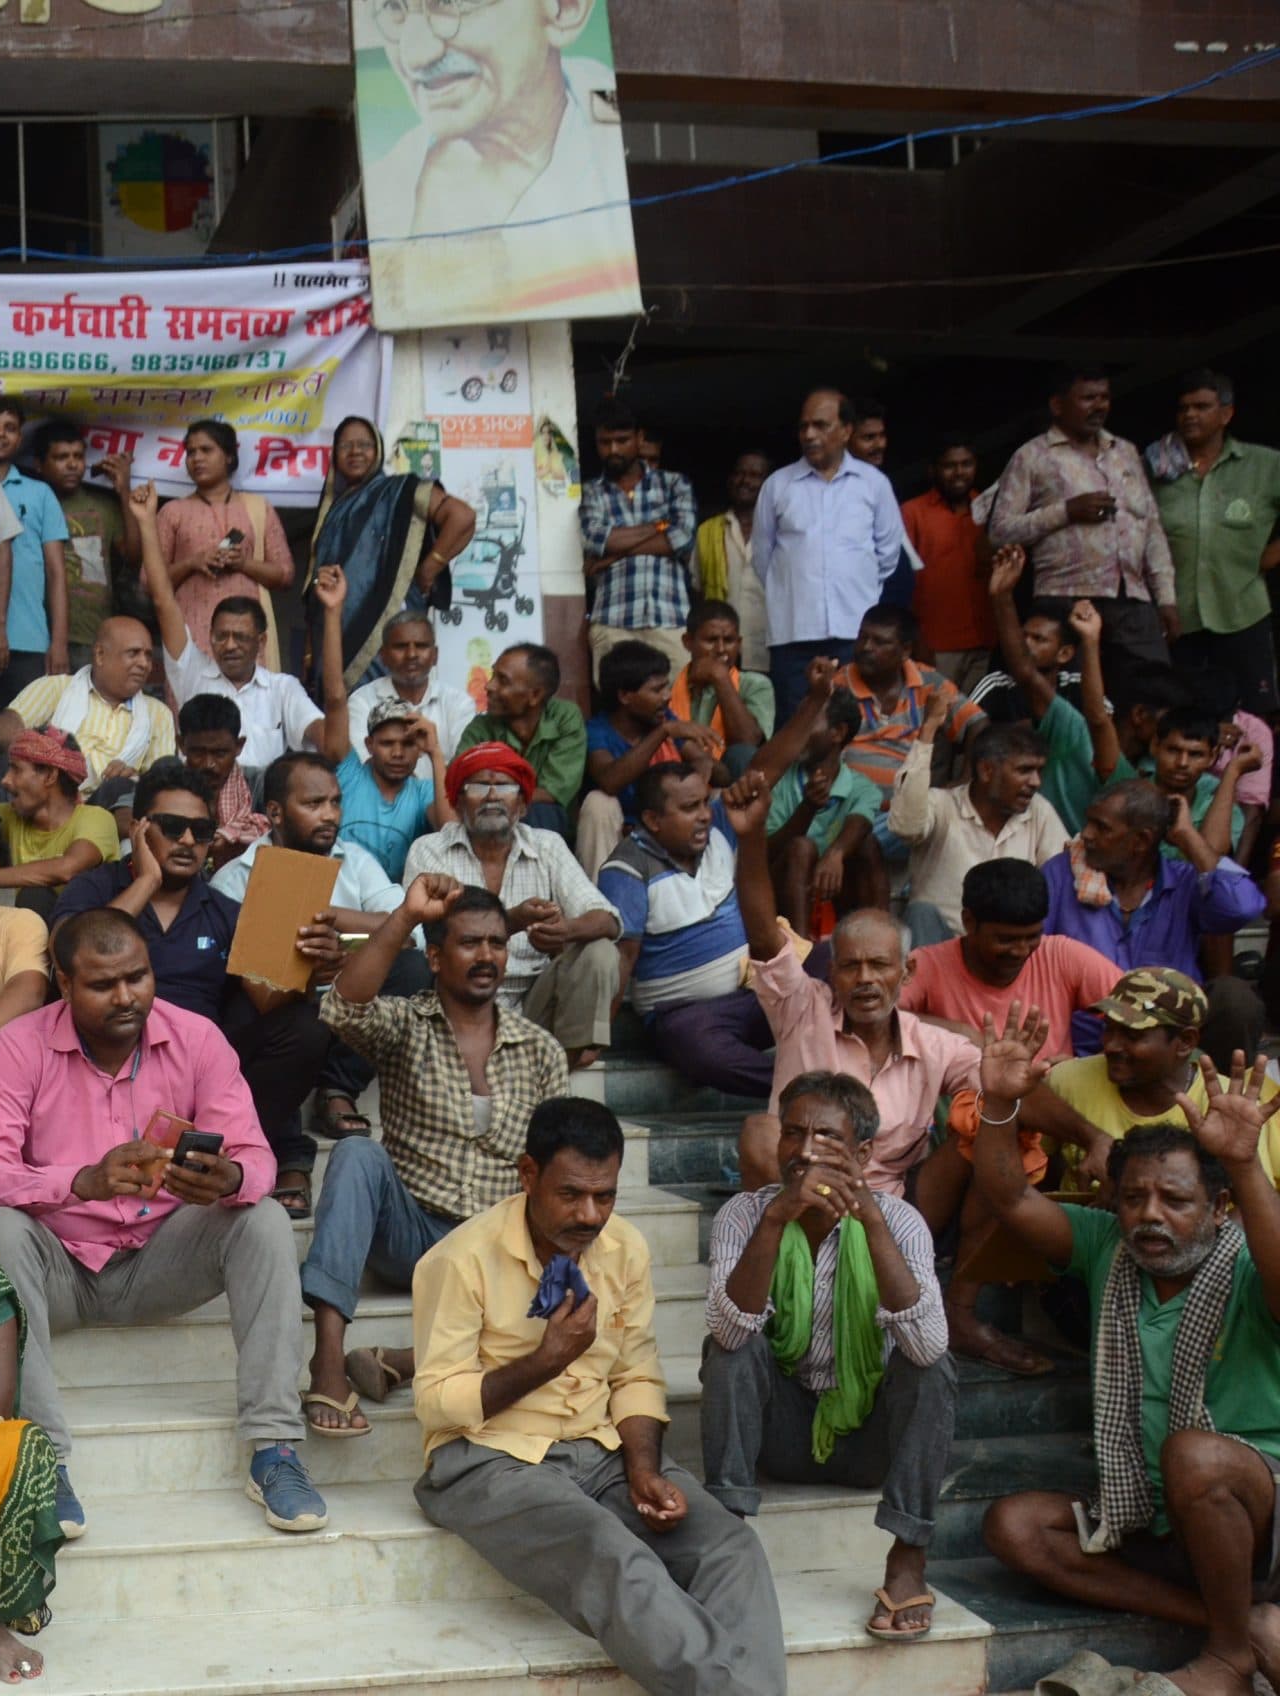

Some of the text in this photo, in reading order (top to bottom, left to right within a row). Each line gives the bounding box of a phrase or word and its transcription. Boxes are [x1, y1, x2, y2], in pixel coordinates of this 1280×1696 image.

[9, 291, 152, 339] कर्मचारी
[442, 414, 528, 433] OYS SHOP
